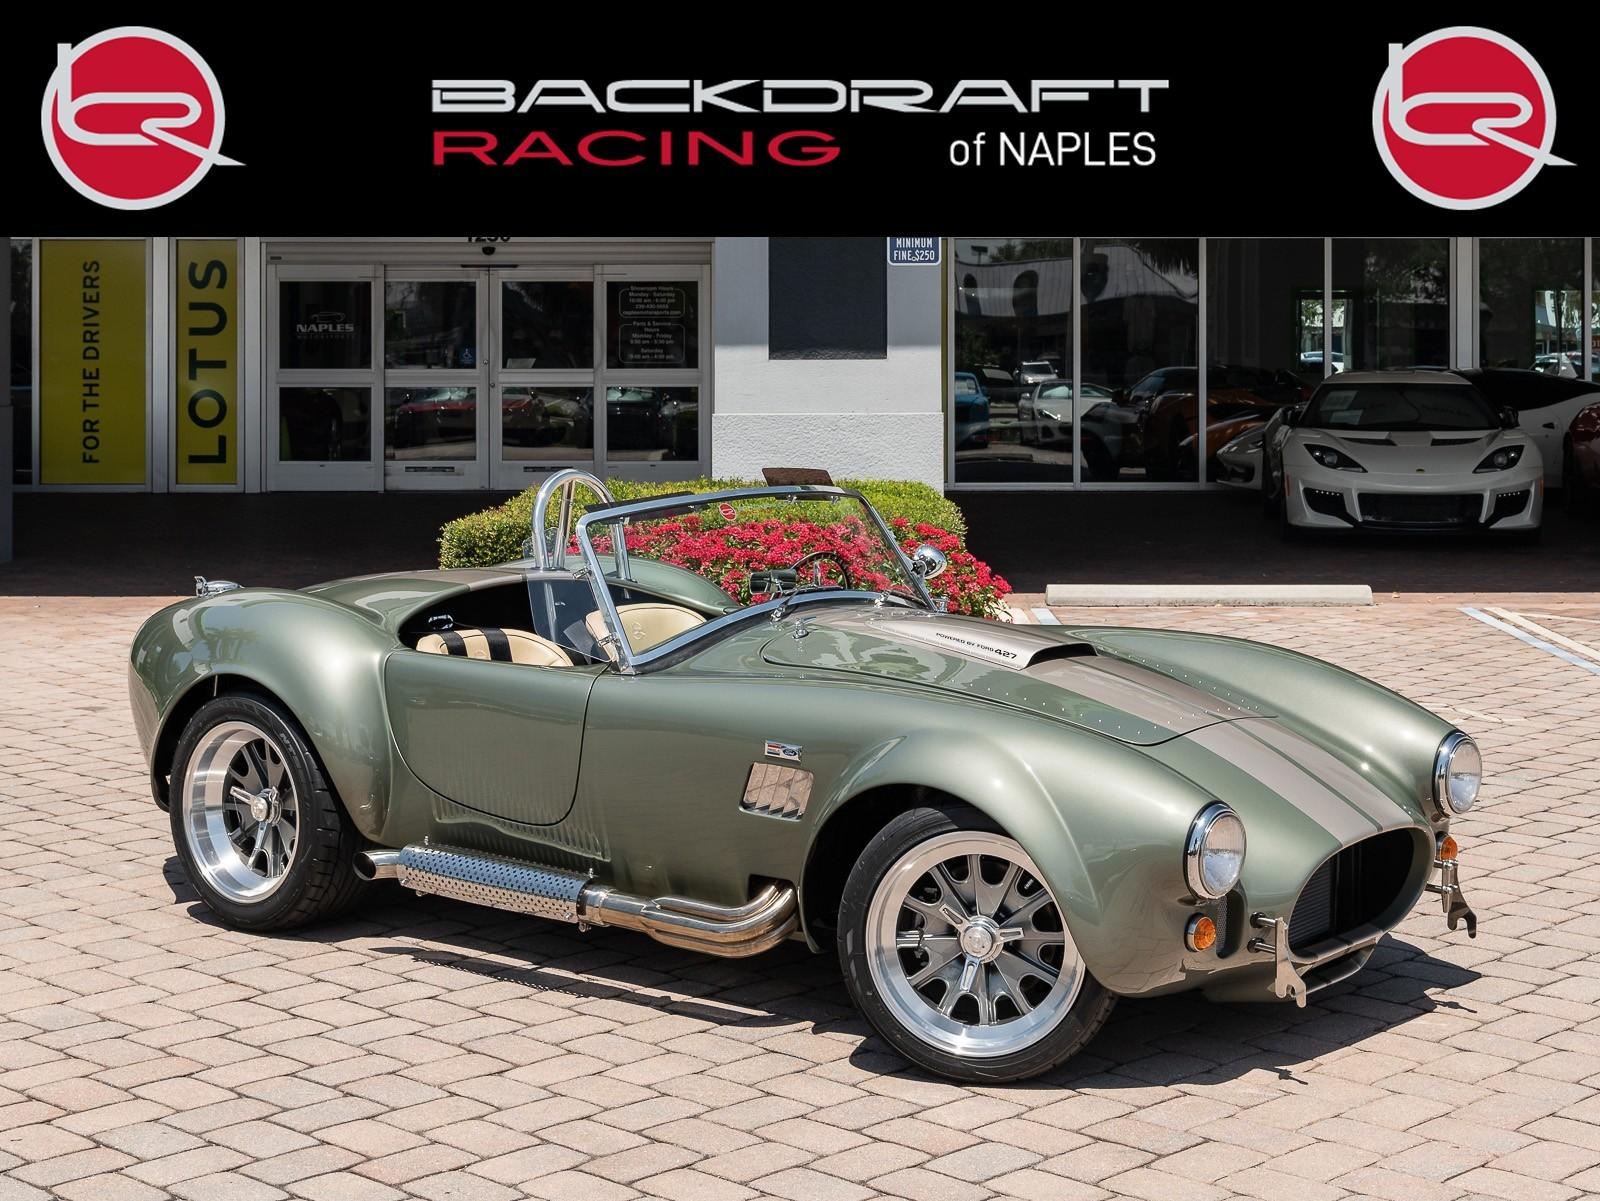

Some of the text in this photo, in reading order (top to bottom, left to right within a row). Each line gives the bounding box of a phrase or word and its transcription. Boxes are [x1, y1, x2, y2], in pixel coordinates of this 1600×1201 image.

[896, 237, 933, 248] MINIMUM
[893, 249, 935, 261] FINE $250
[296, 323, 355, 333] NAPLES
[82, 260, 100, 464] FOR THE DRIVERS
[188, 259, 228, 464] LOTUS
[935, 632, 966, 644] POWERED
[976, 643, 994, 652] FORD
[994, 648, 1018, 660] 427
